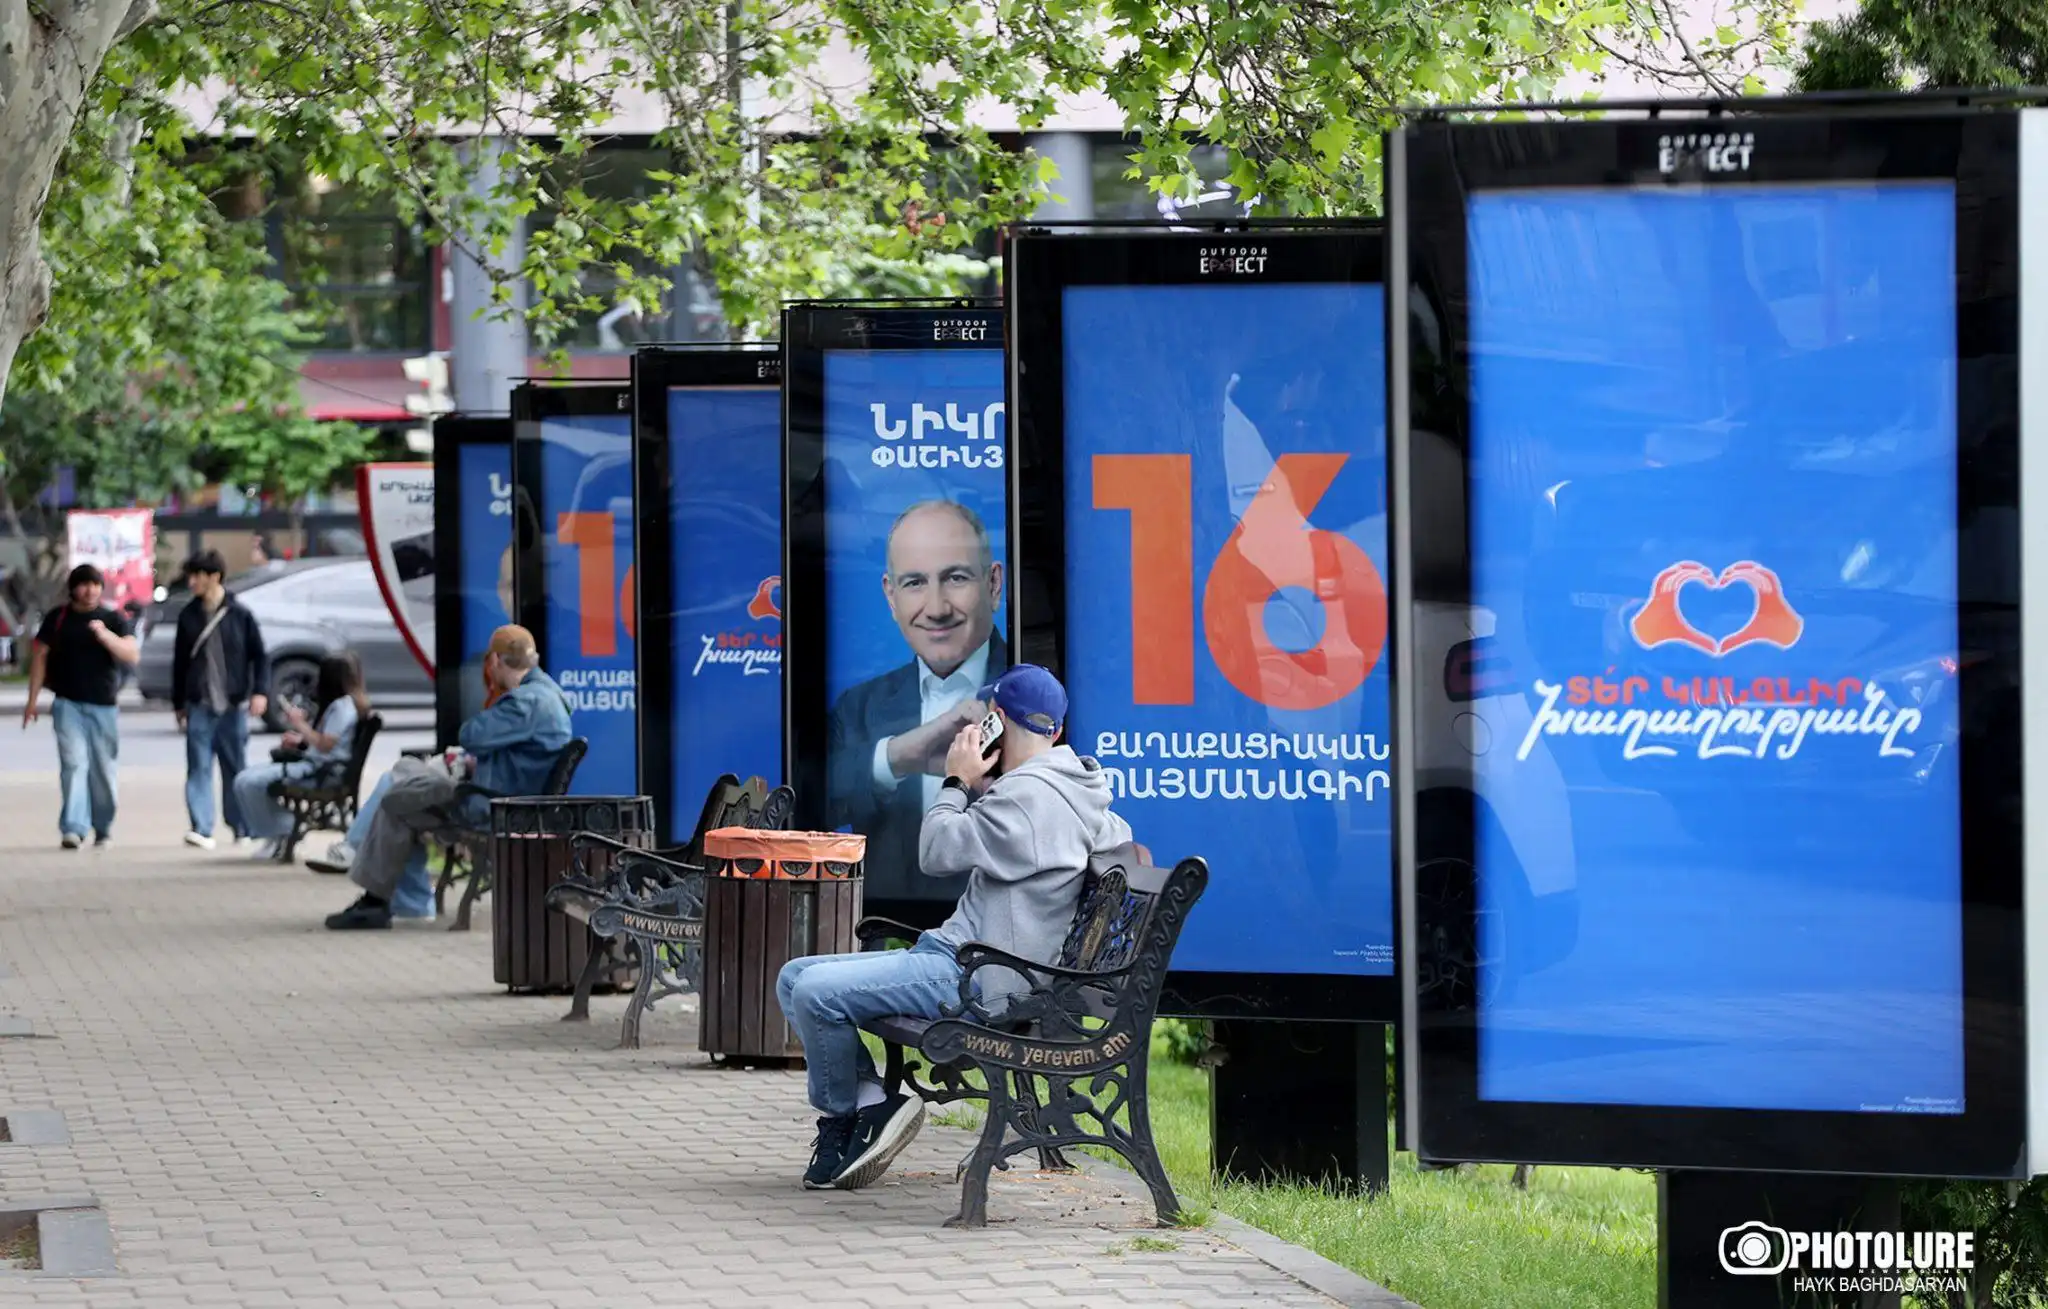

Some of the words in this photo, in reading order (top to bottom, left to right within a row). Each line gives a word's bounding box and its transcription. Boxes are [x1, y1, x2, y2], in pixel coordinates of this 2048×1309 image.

[1200, 247, 1268, 256] OUTDOOR
[557, 512, 635, 657] 1
[1092, 452, 1388, 711] 16
[692, 634, 782, 676] խաղա
[1664, 675, 1863, 706] ԿԱՆԳՆԻՐ
[1096, 731, 1390, 760] ՔԱՂԱՔԱՑԻԱԿԱՆ
